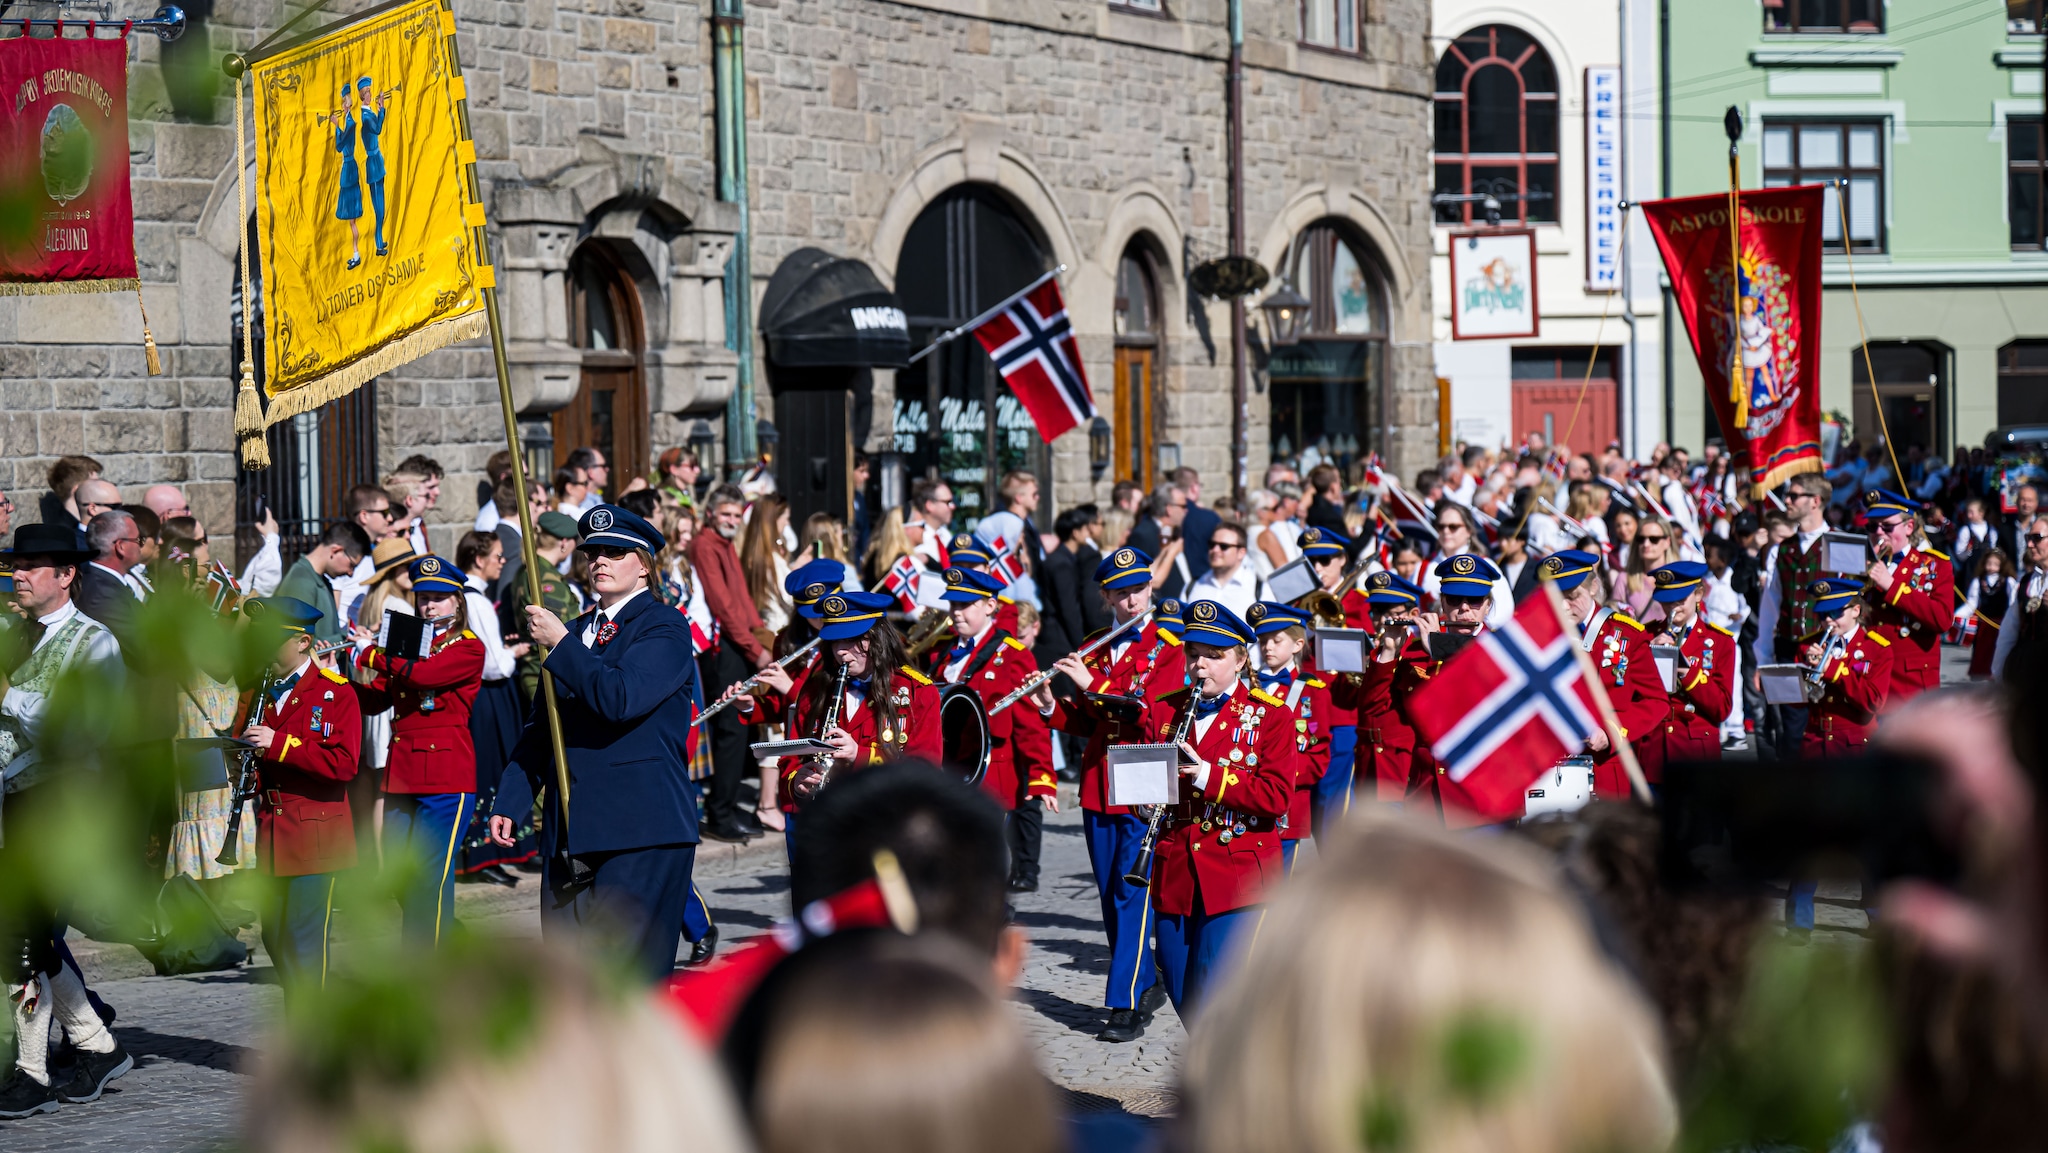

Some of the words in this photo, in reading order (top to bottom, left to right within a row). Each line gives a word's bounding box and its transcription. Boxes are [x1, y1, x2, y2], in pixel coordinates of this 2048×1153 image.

[1597, 74, 1614, 280] FRELSESARMEEN
[1669, 206, 1733, 235] ASPØ
[1741, 206, 1806, 226] SKOLE
[44, 224, 89, 252] ÅLESUND
[327, 283, 364, 317] TONER
[893, 434, 916, 453] PUB
[953, 433, 974, 452] PUB
[1008, 430, 1029, 449] PUB
